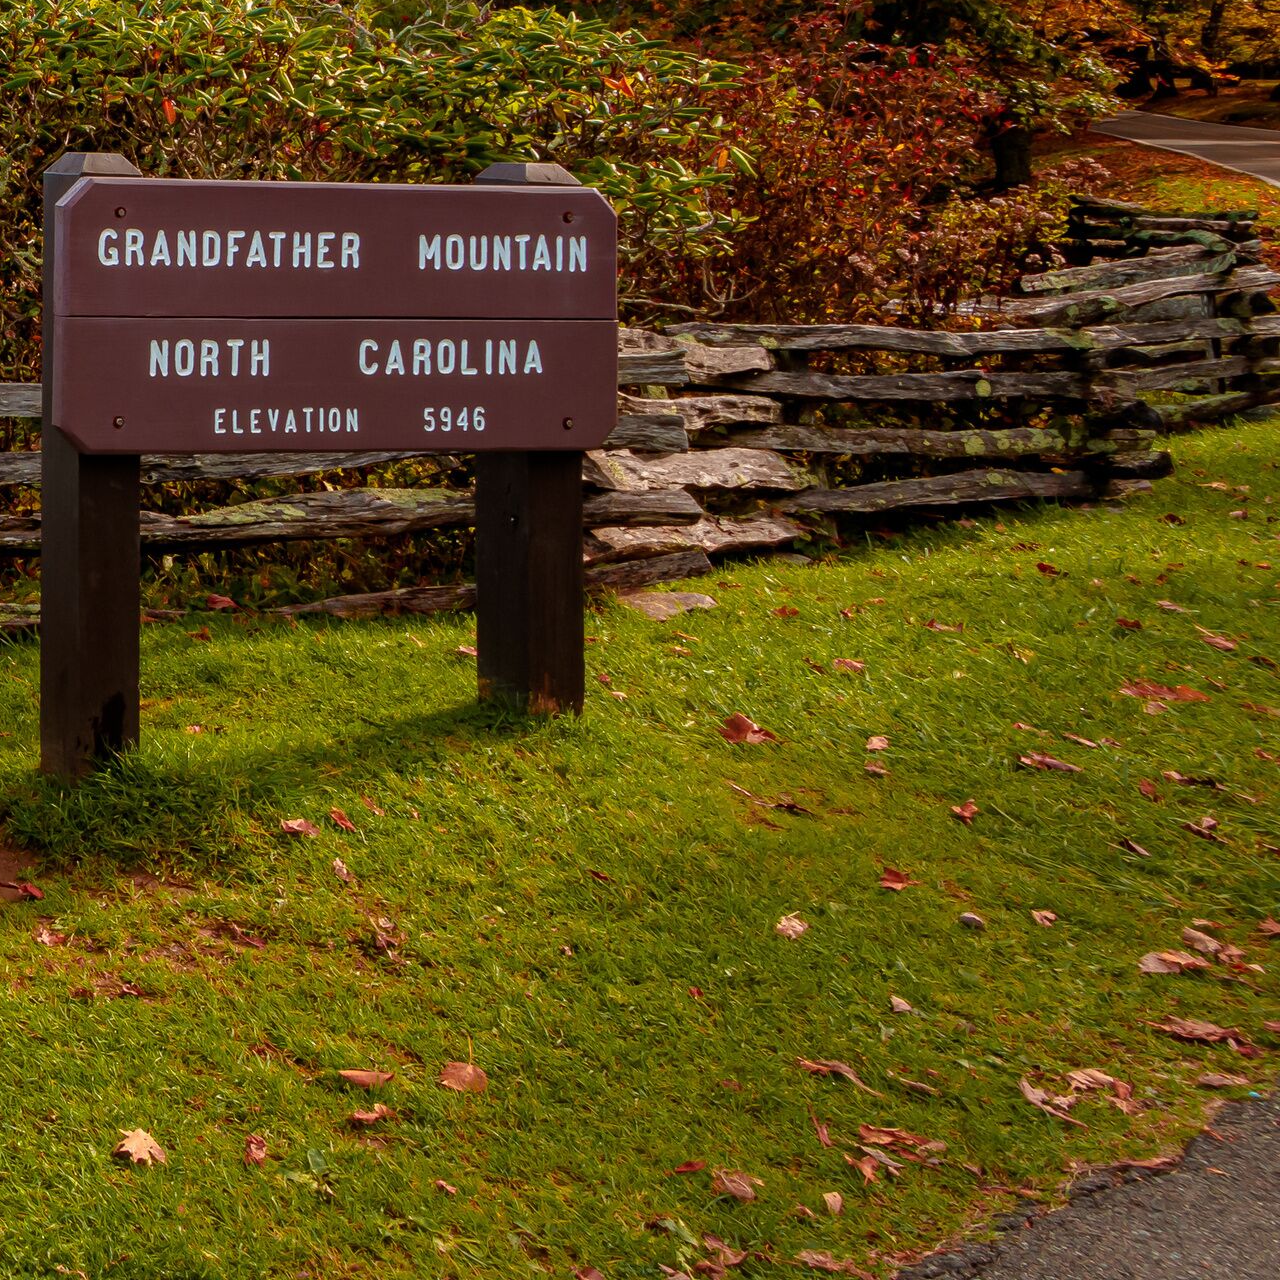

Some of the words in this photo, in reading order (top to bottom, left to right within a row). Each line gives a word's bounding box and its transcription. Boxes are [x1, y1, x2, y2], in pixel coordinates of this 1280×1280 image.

[98, 228, 360, 268] GRANDFATHER
[419, 234, 587, 272] MOUNTAIN
[150, 339, 270, 377] NORTH
[359, 339, 543, 375] CAROLINA
[215, 408, 359, 434] ELEVATION
[423, 407, 486, 432] 5946
